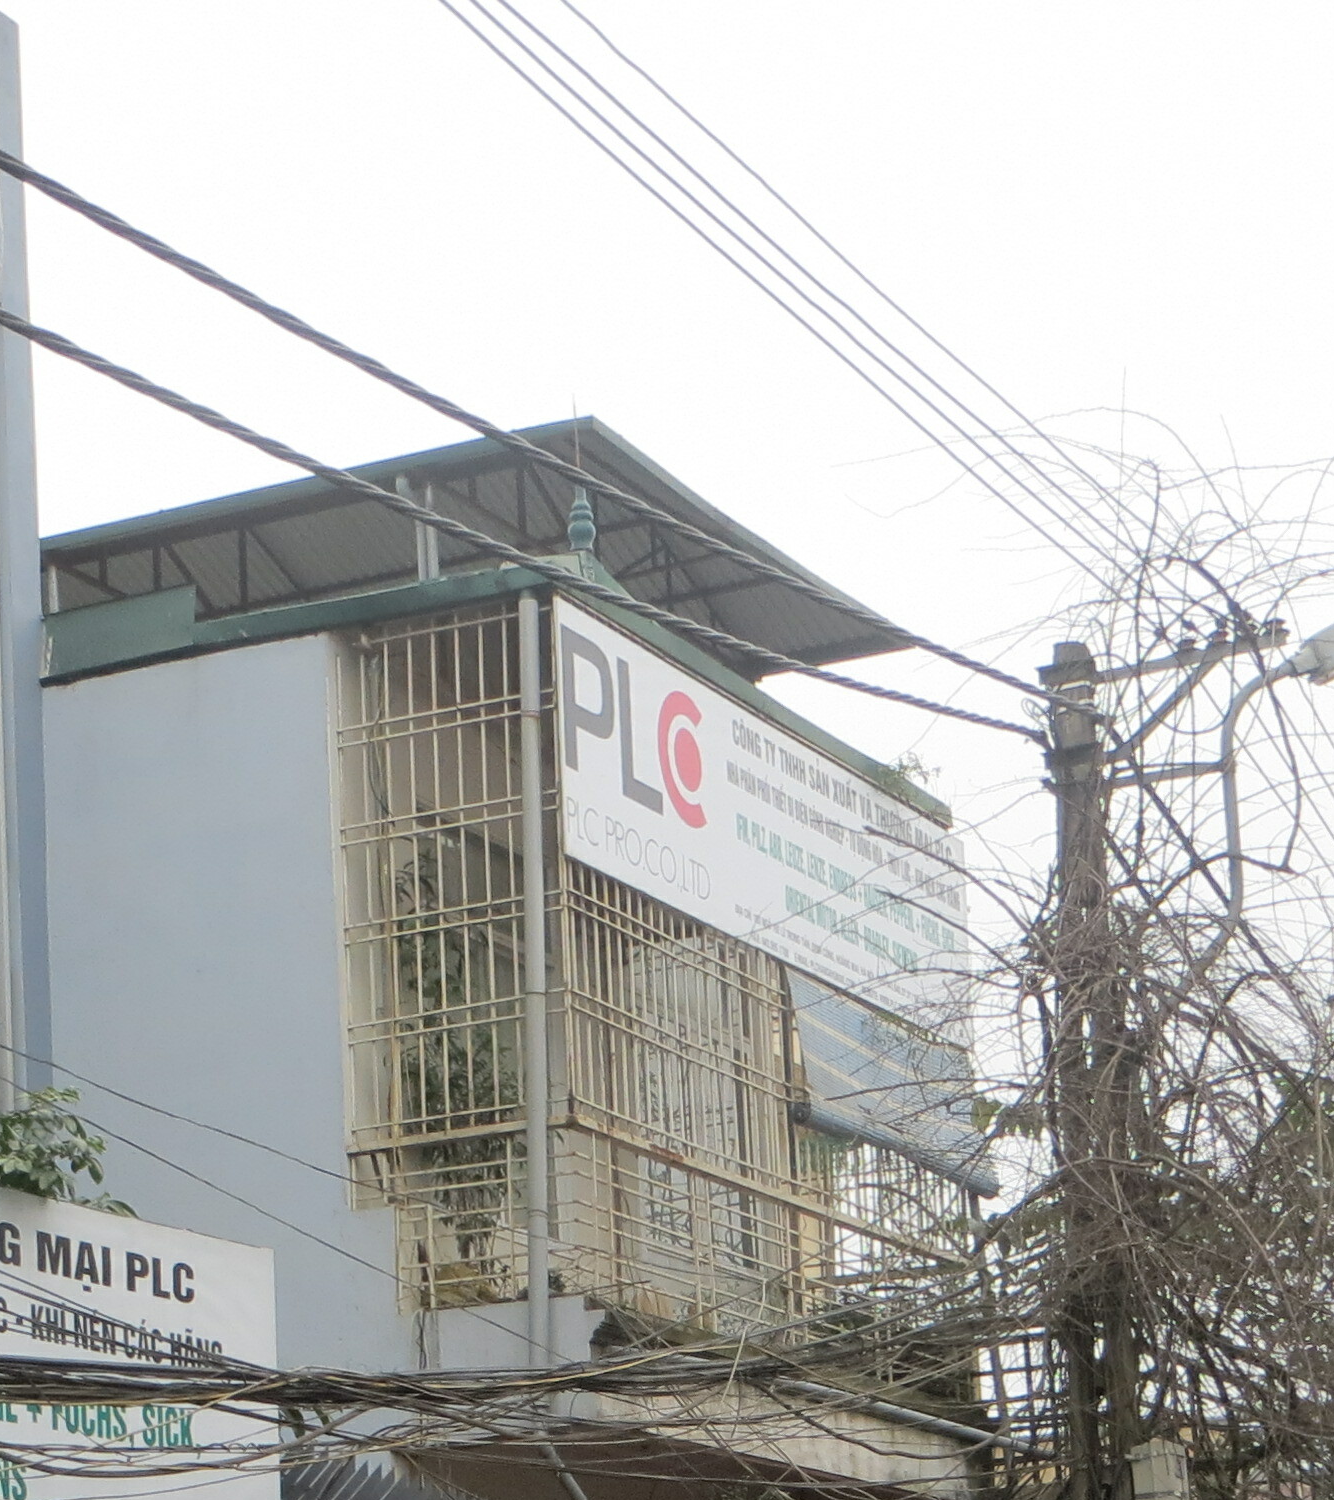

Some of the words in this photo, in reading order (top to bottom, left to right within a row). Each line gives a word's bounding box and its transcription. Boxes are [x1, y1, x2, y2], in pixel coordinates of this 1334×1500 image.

[731, 718, 762, 759] CÔNG
[763, 737, 776, 767] TY
[778, 746, 807, 786] TNHH
[808, 757, 830, 799] SẢN
[565, 796, 600, 847] PLC
[35, 1229, 112, 1292] MẠI
[125, 1250, 196, 1304] PLC
